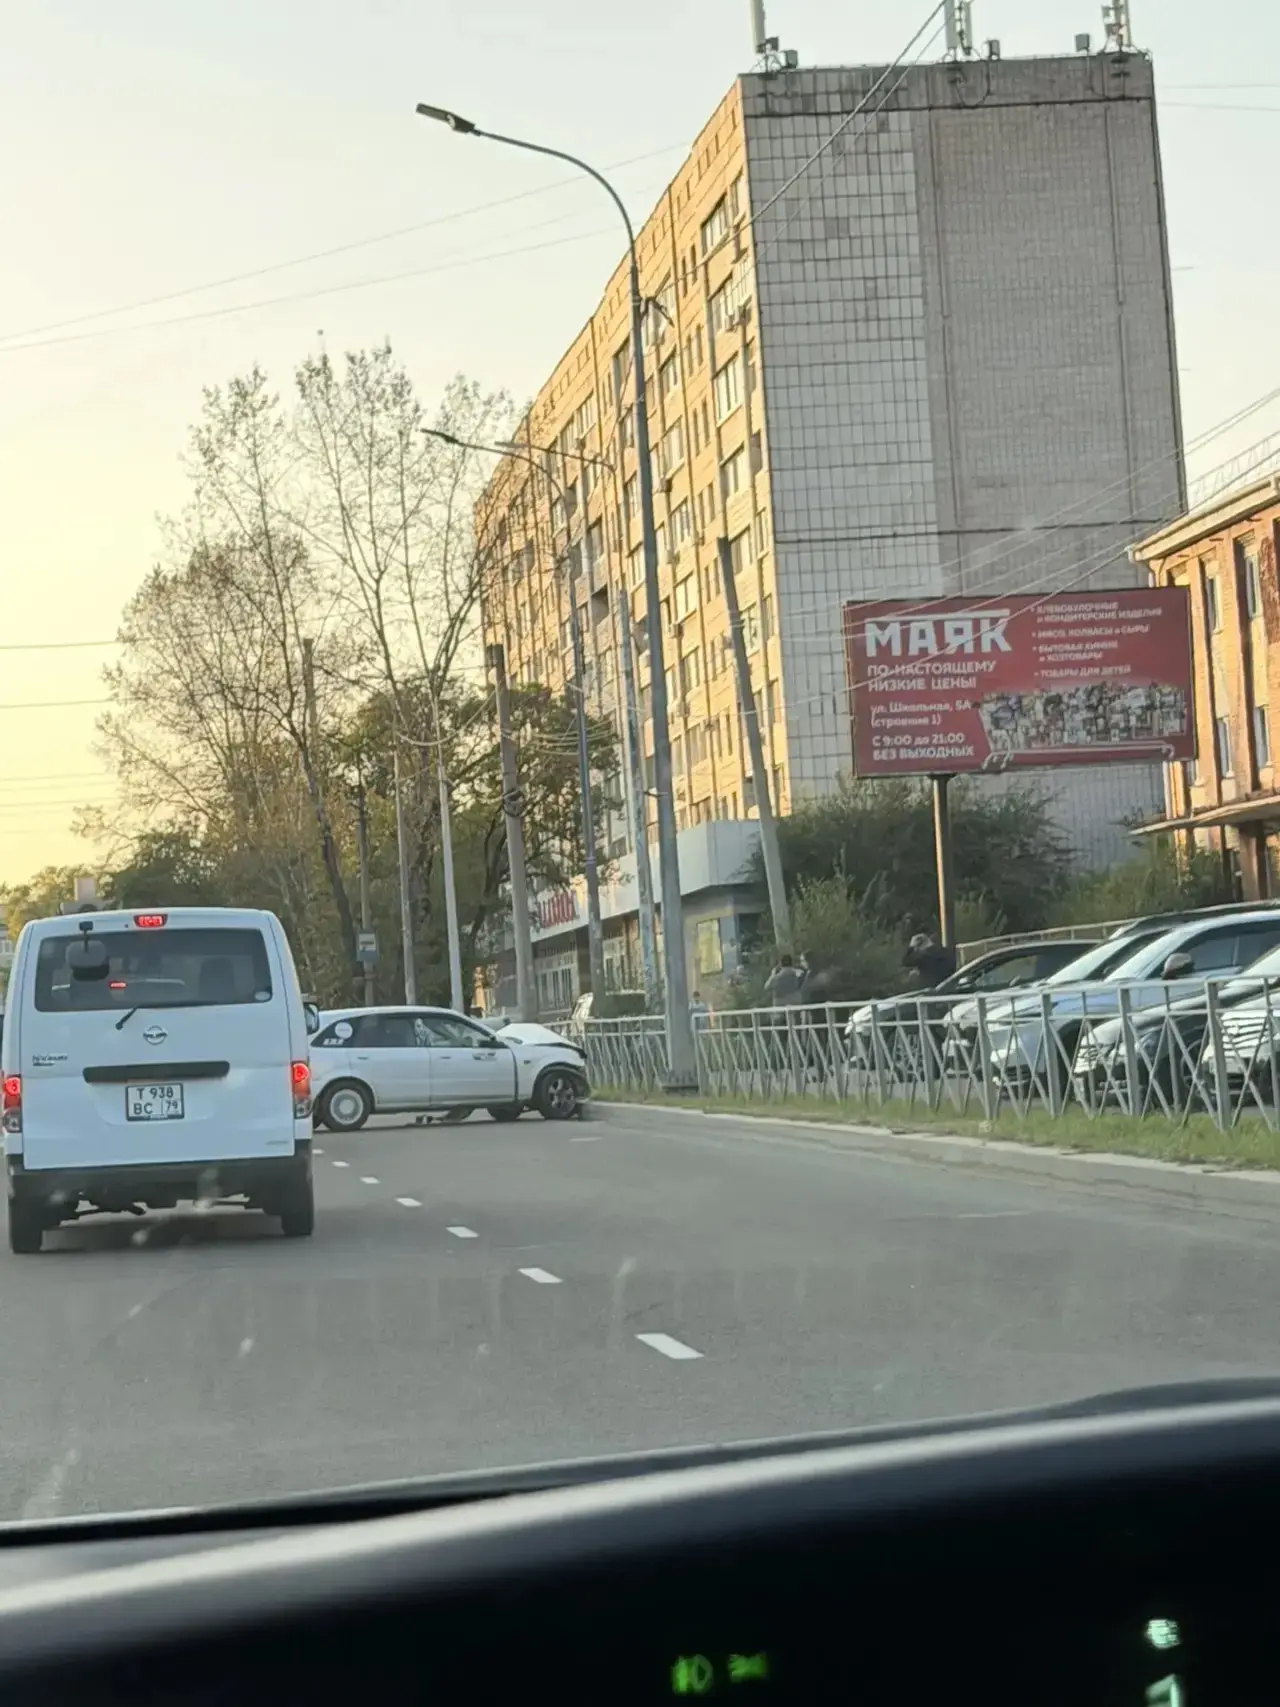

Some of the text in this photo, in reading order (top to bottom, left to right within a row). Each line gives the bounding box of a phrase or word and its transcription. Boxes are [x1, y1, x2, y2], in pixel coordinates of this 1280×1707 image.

[864, 616, 1012, 657] МАЯК
[867, 660, 996, 677] ПО-НАСТОЯЩЕМУ
[868, 676, 976, 692] НИЗКИЕ ЦЕНЫ!
[872, 732, 965, 747] С 9:00 до 21:00
[873, 745, 974, 760] БЕЗ ВЫХОДНЫХ
[150, 1086, 174, 1099] 938
[133, 1101, 178, 1115] ВС 79
